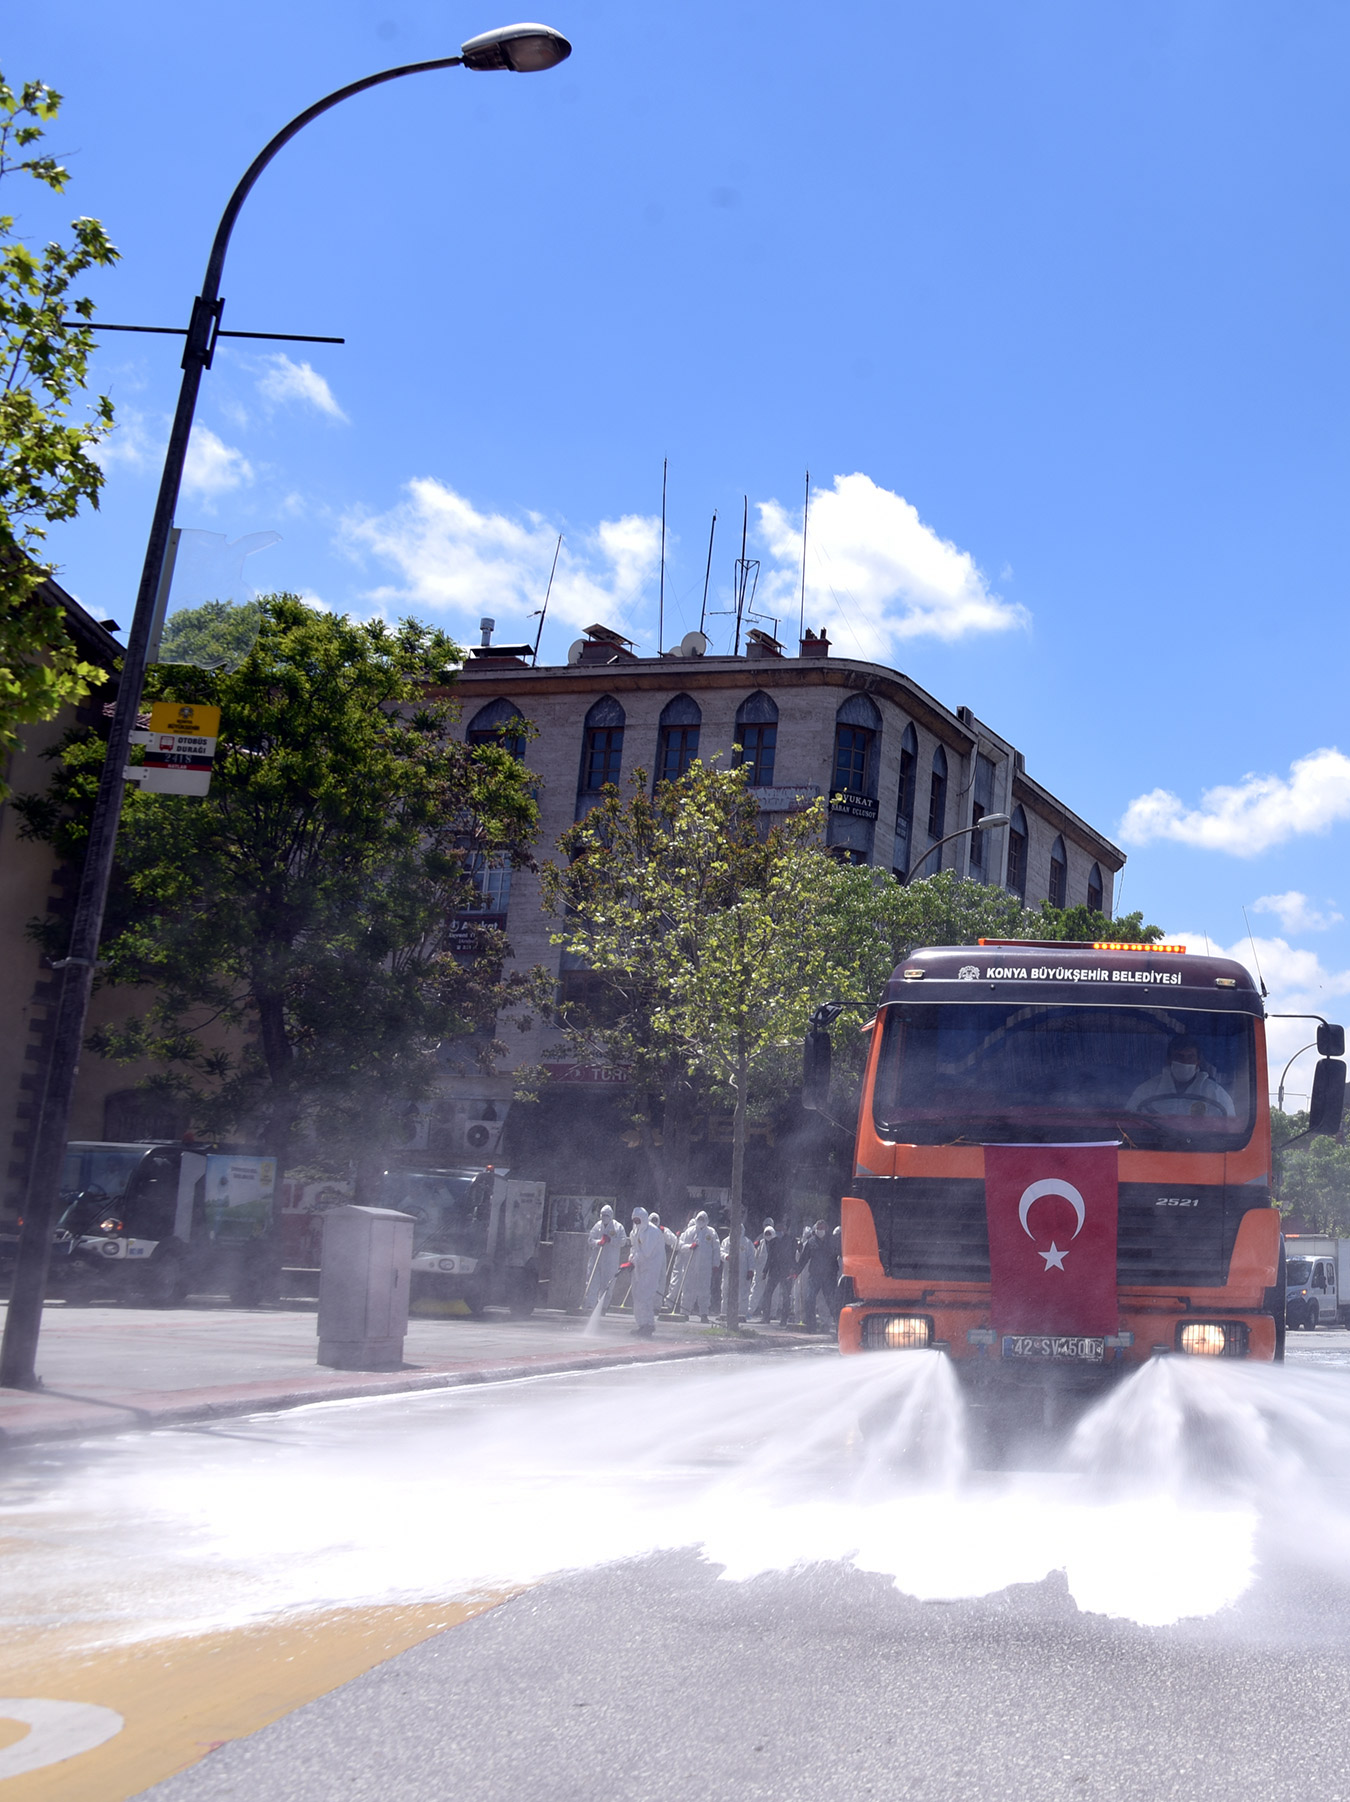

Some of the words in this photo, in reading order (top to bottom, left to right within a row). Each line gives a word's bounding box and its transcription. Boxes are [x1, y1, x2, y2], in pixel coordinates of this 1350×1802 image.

[178, 737, 208, 746] OTOBÜS
[176, 745, 206, 753] DURAĞI
[841, 793, 873, 807] VUKAT
[986, 968, 1028, 979] KONYA
[1030, 967, 1109, 983] BÜYÜKŞEHİR
[1112, 970, 1182, 985] BELEDİYESİ
[1155, 1197, 1199, 1207] 2521
[1014, 1339, 1032, 1355] 42
[1041, 1340, 1059, 1355] SV
